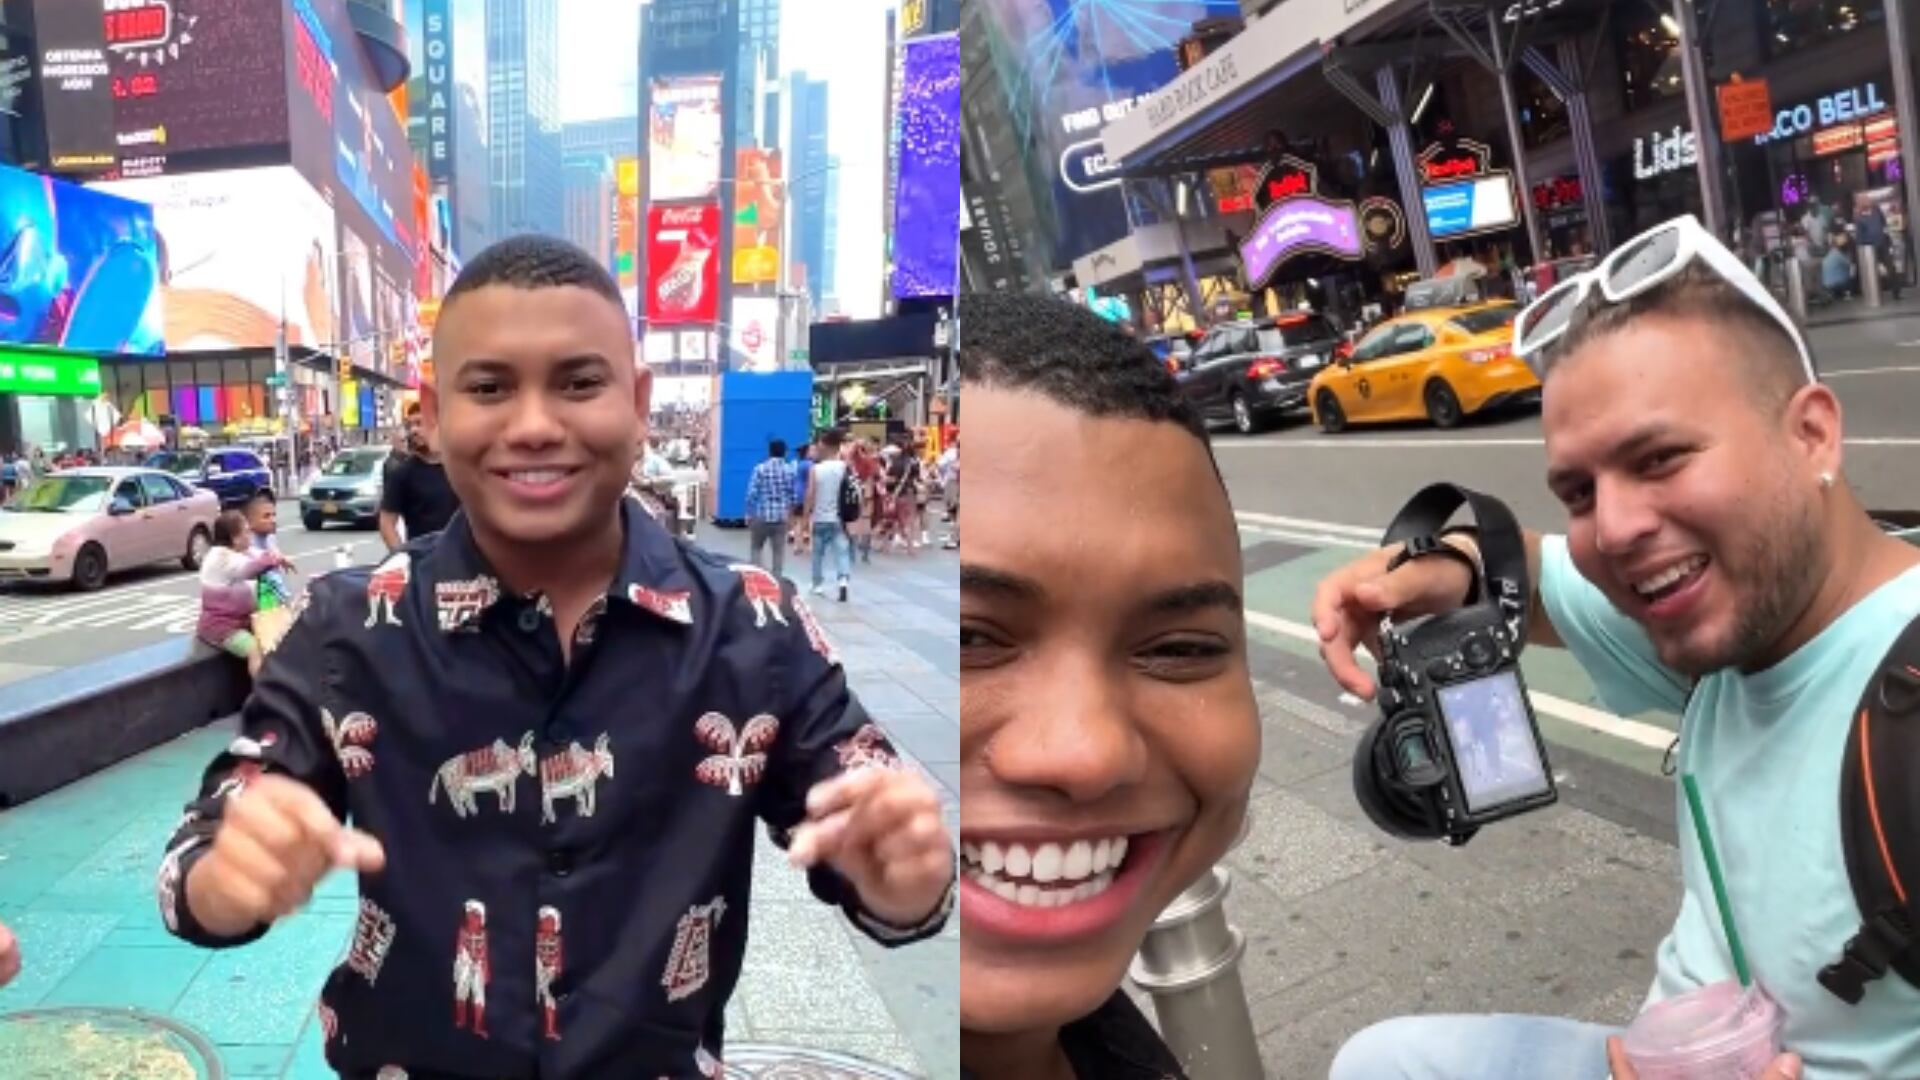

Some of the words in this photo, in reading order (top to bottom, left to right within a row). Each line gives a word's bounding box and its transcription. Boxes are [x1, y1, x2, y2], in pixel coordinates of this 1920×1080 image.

[428, 16, 446, 158] SQUARE
[1146, 93, 1178, 128] HARD
[1173, 78, 1207, 110] ROCK
[1206, 53, 1238, 90] CAFE
[1818, 83, 1885, 125] BELL
[1062, 107, 1100, 133] FIND
[1634, 126, 1698, 179] Lids
[972, 196, 1000, 263] SQUARE
